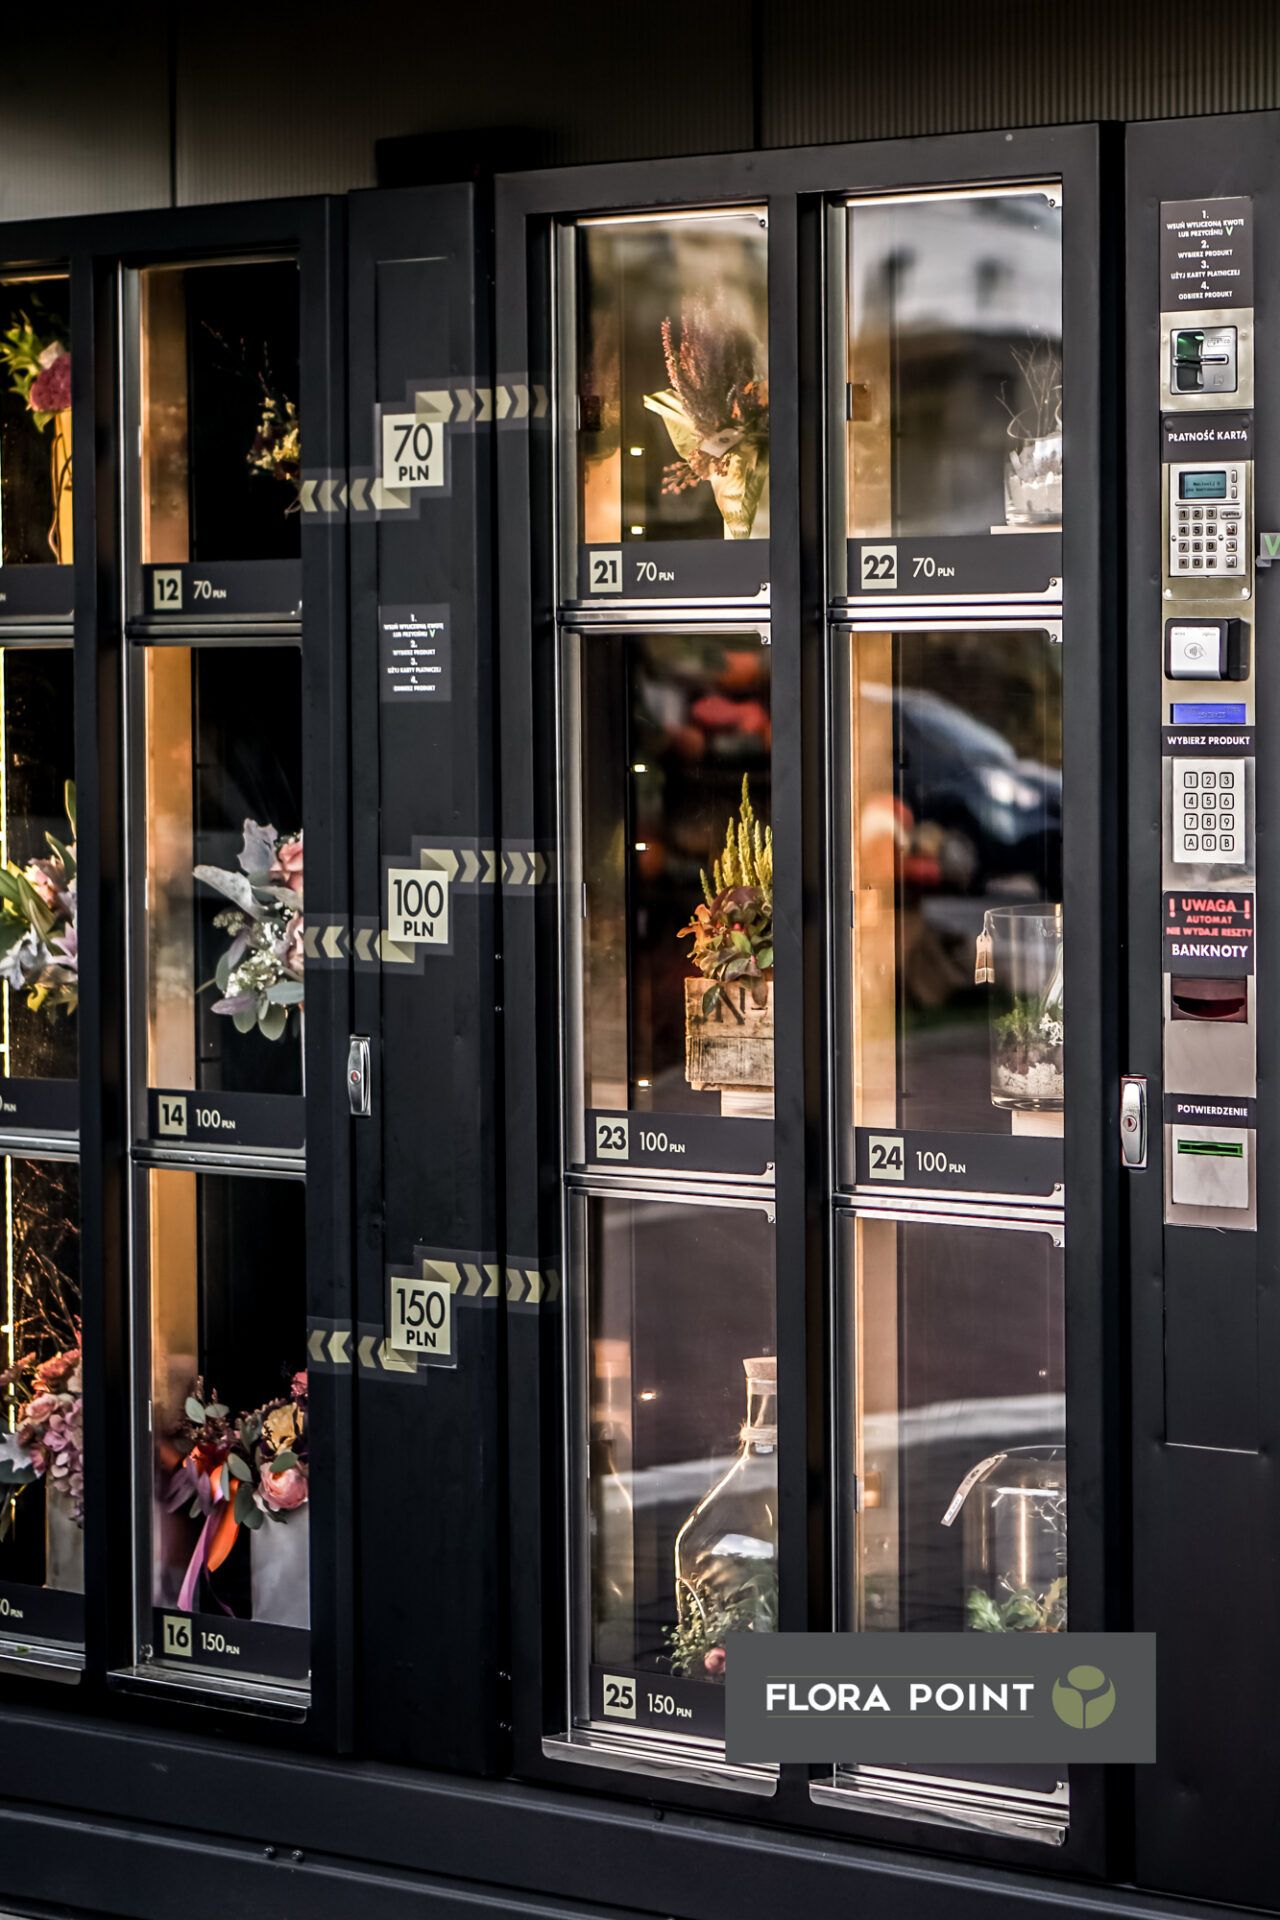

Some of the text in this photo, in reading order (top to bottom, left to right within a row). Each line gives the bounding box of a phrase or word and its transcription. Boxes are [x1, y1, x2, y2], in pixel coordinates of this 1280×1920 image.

[1202, 210, 1209, 219] 1.
[1226, 226, 1234, 236] V
[1201, 240, 1209, 248] 2.
[1201, 260, 1209, 269] 3.
[1201, 281, 1209, 290] 4.
[394, 423, 433, 462] 70
[1168, 430, 1248, 442] PŁATNOŚĆ KARTĄ
[399, 465, 429, 481] PLN
[594, 560, 674, 584] 21 70 PLN
[864, 554, 955, 580] 22 70 PLN
[157, 578, 179, 601] 12
[194, 580, 212, 599] 70
[1167, 737, 1250, 745] WYBIERZ PRODUKT
[393, 879, 444, 918] 100
[1182, 898, 1237, 912] UWAGA
[1186, 915, 1232, 924] AUTOMAT
[404, 921, 434, 937] PLN
[1166, 927, 1252, 937] NIE WYDAJE RESZTY
[1172, 944, 1248, 958] BANKNOTY
[162, 1103, 184, 1126] 14
[196, 1109, 220, 1128] 100
[1177, 1104, 1248, 1116] POTWIERDZENIE
[598, 1125, 685, 1153] 23 100 PLN
[872, 1144, 966, 1173] 24 100 PLN
[396, 1288, 445, 1329] 150
[406, 1330, 436, 1347] PLN
[167, 1624, 189, 1648] 16
[201, 1632, 225, 1652] 150
[606, 1683, 692, 1718] 25 150 PLN
